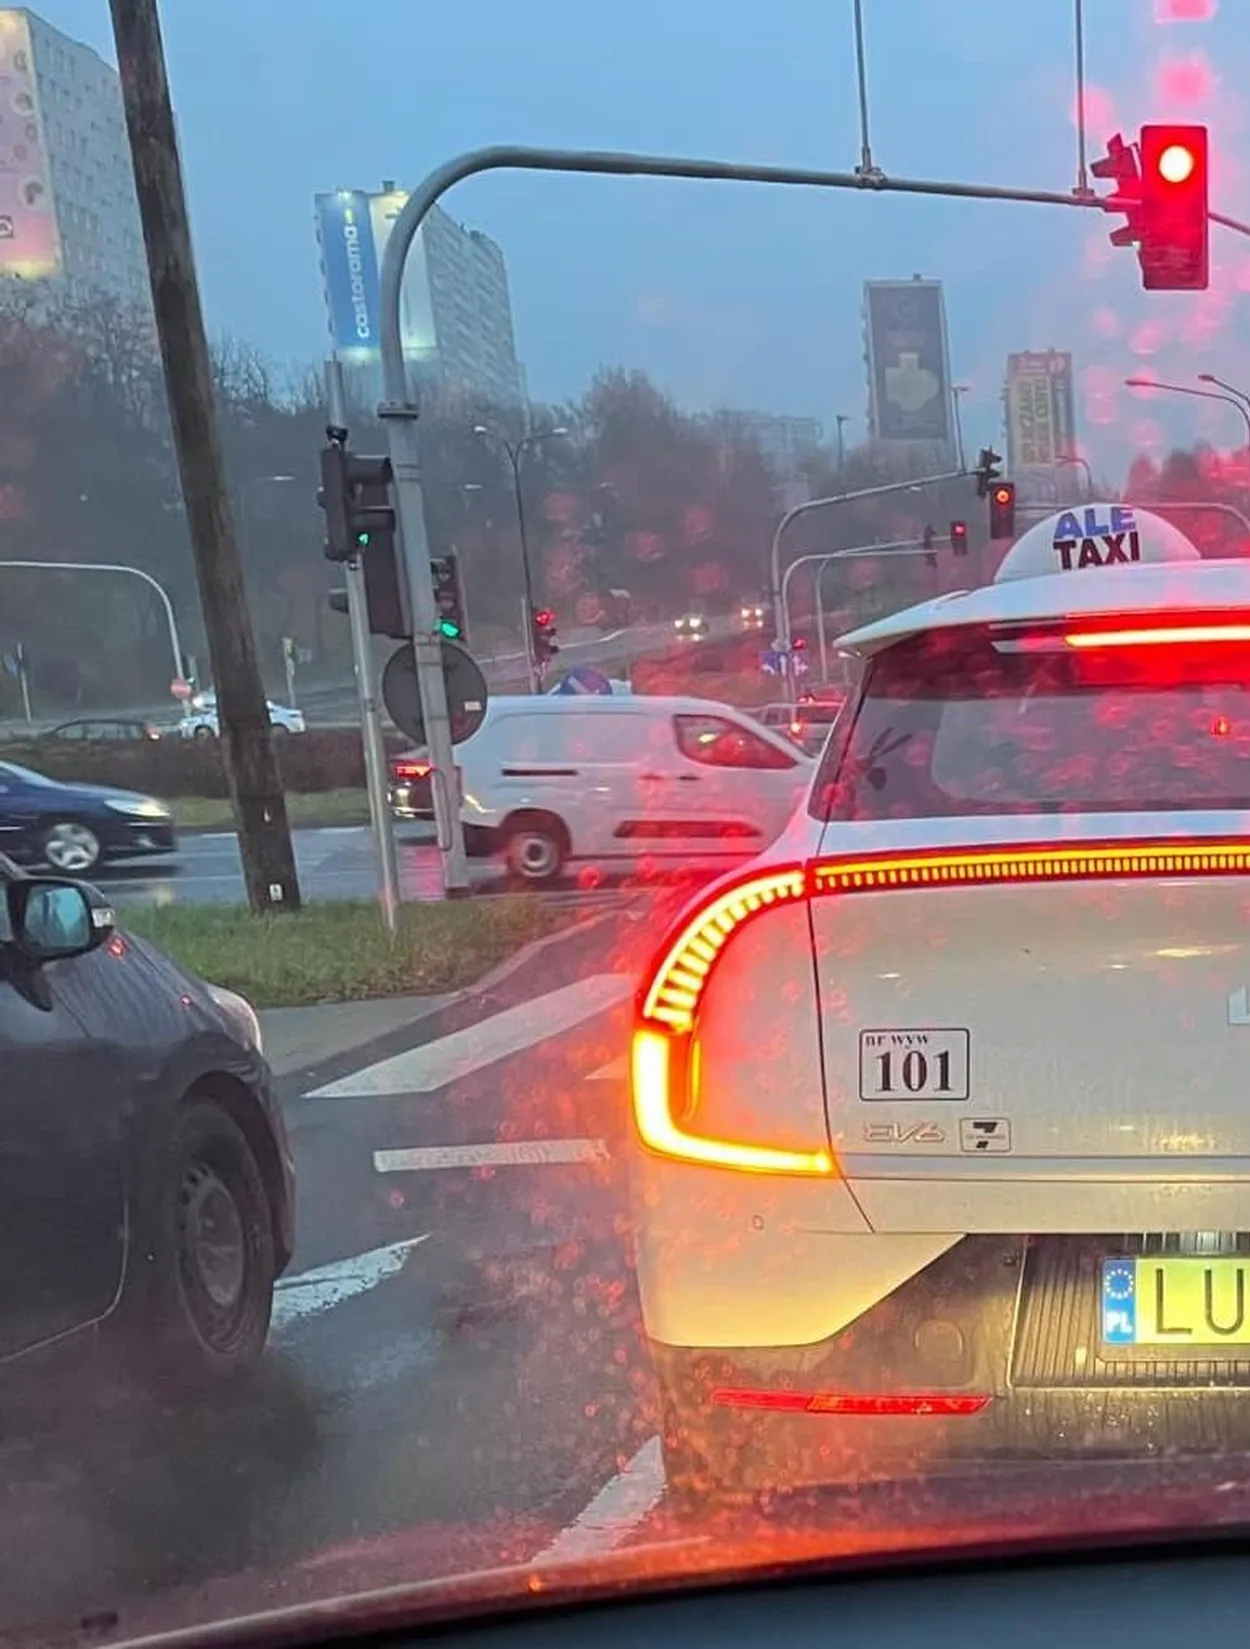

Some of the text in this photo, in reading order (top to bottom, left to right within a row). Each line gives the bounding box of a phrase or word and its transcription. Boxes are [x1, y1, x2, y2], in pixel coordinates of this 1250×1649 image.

[344, 225, 370, 338] castorama
[1054, 506, 1137, 539] ALE
[1053, 531, 1140, 570] TAXI
[866, 1034, 928, 1048] nr wyw
[875, 1050, 954, 1092] 101
[864, 1121, 946, 1144] EV6
[1155, 1267, 1244, 1336] LU
[1106, 1312, 1133, 1333] PL
